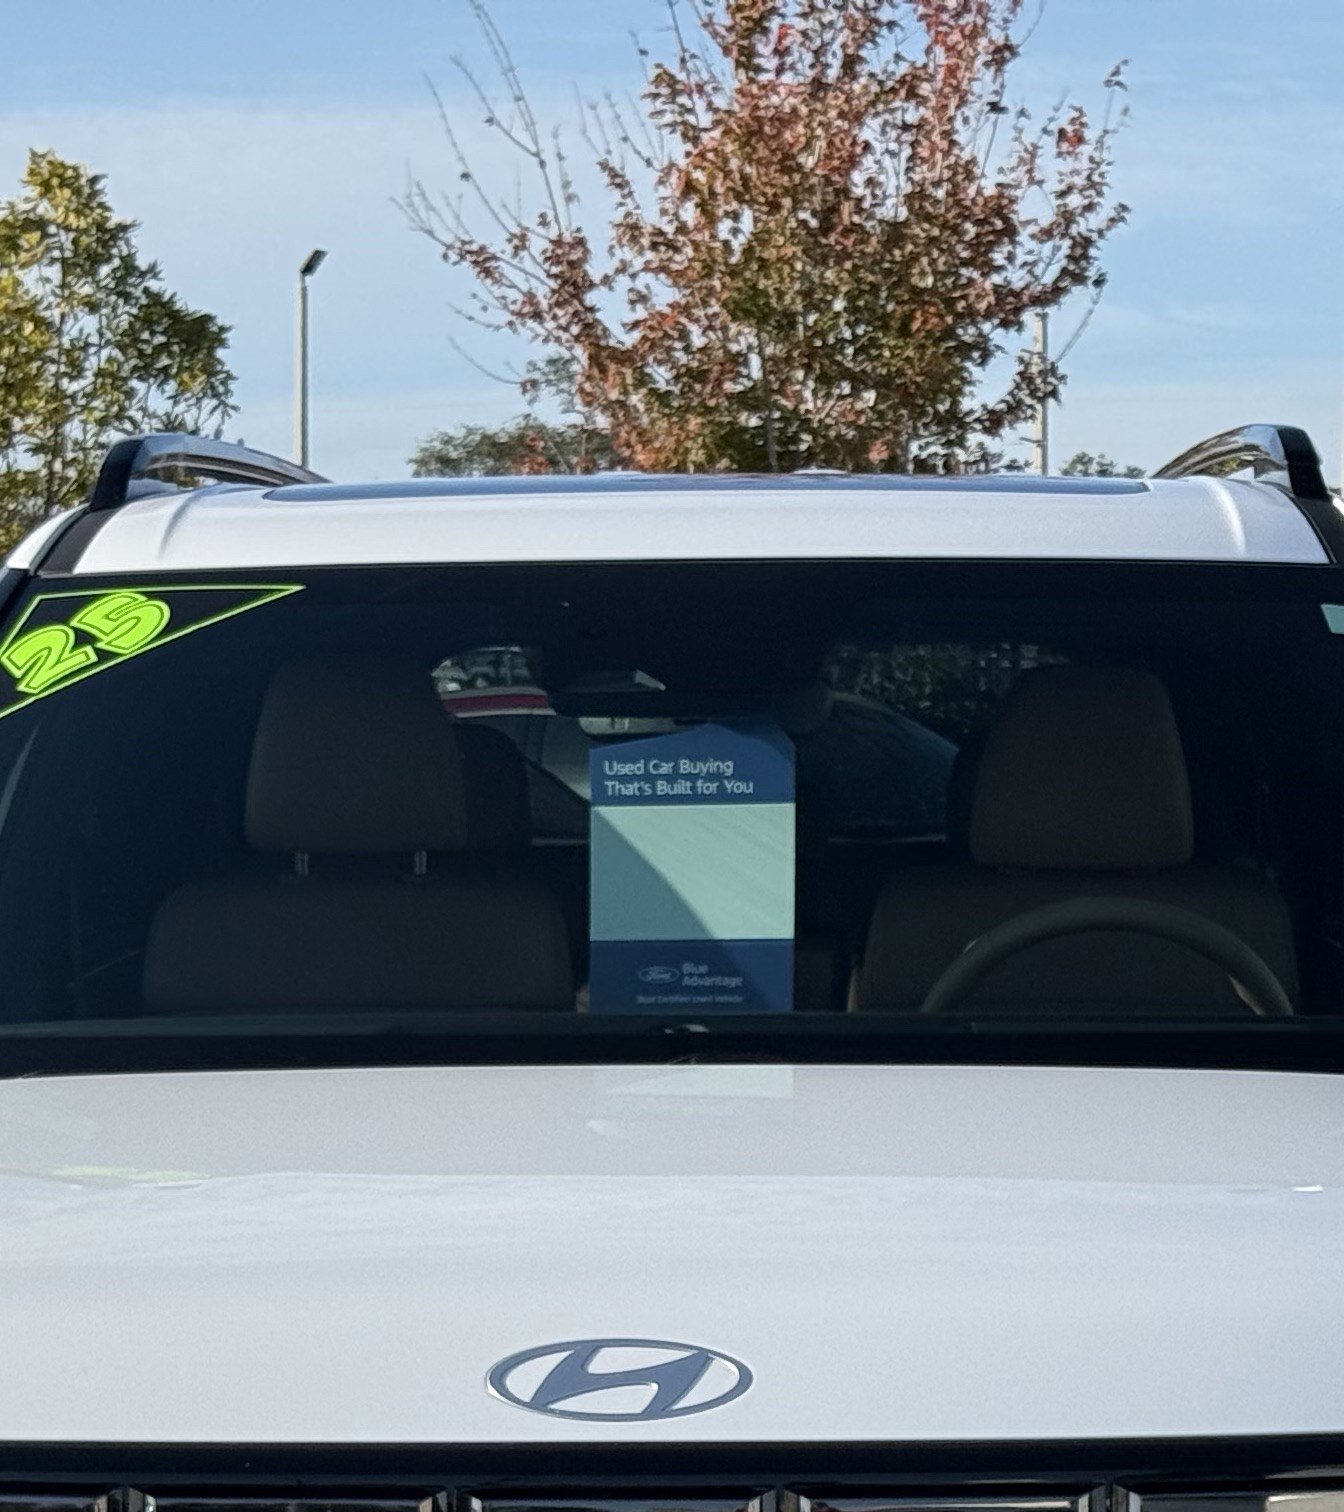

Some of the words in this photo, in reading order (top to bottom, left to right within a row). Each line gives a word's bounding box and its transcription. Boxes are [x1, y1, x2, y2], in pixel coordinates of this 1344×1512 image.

[1, 591, 172, 694] 25
[604, 759, 644, 775] Used
[649, 760, 674, 775] Car
[679, 759, 734, 776] Buying
[604, 780, 652, 796] That's
[656, 780, 693, 796] Built
[696, 779, 719, 795] for
[723, 779, 754, 794] You
